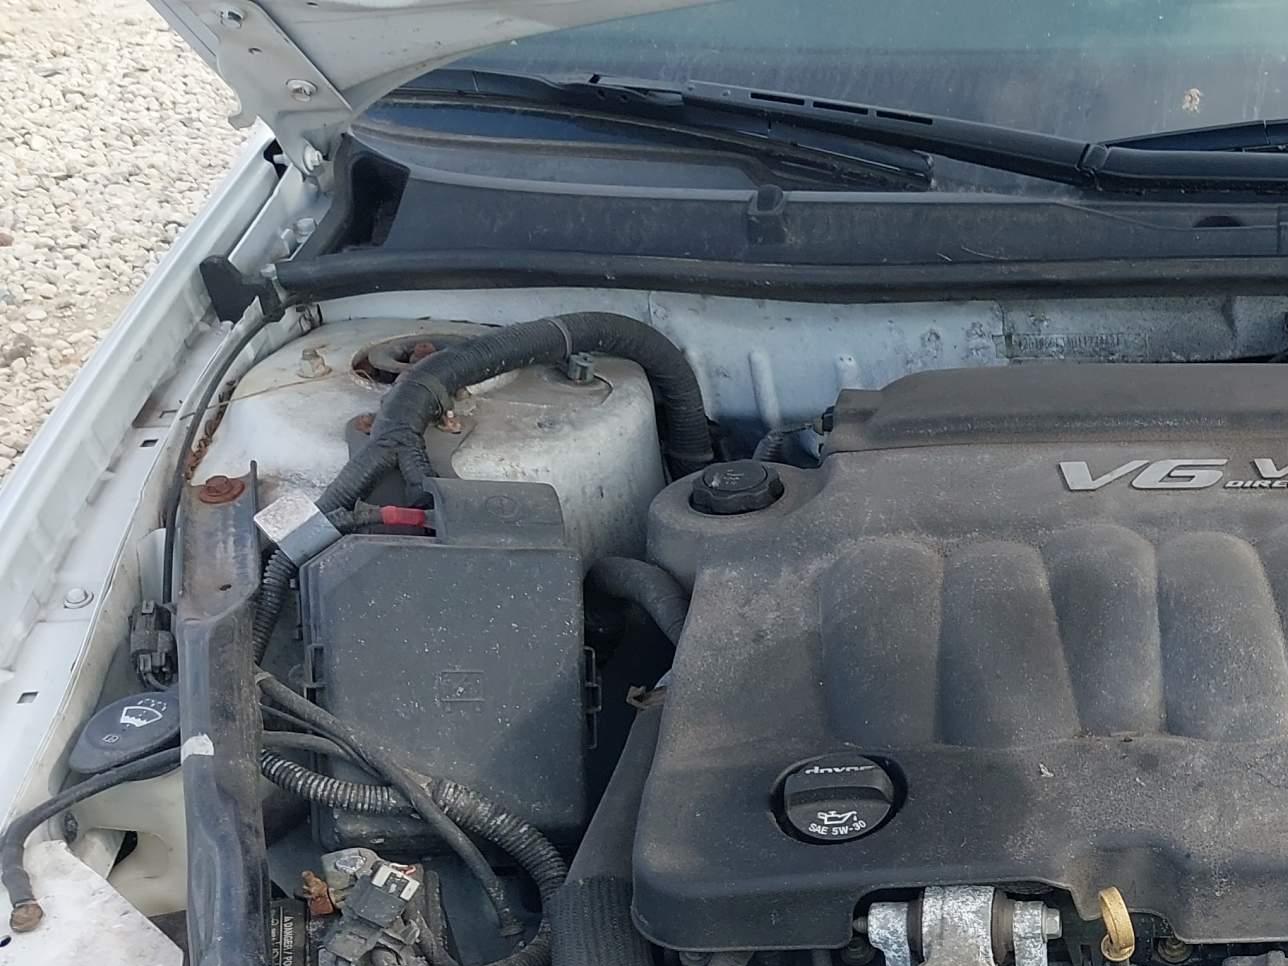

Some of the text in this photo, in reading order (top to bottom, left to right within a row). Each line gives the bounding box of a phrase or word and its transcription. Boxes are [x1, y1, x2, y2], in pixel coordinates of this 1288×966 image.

[1058, 459, 1229, 490] V6
[808, 820, 867, 836] SAE 5W-30
[283, 922, 293, 950] DANGER
